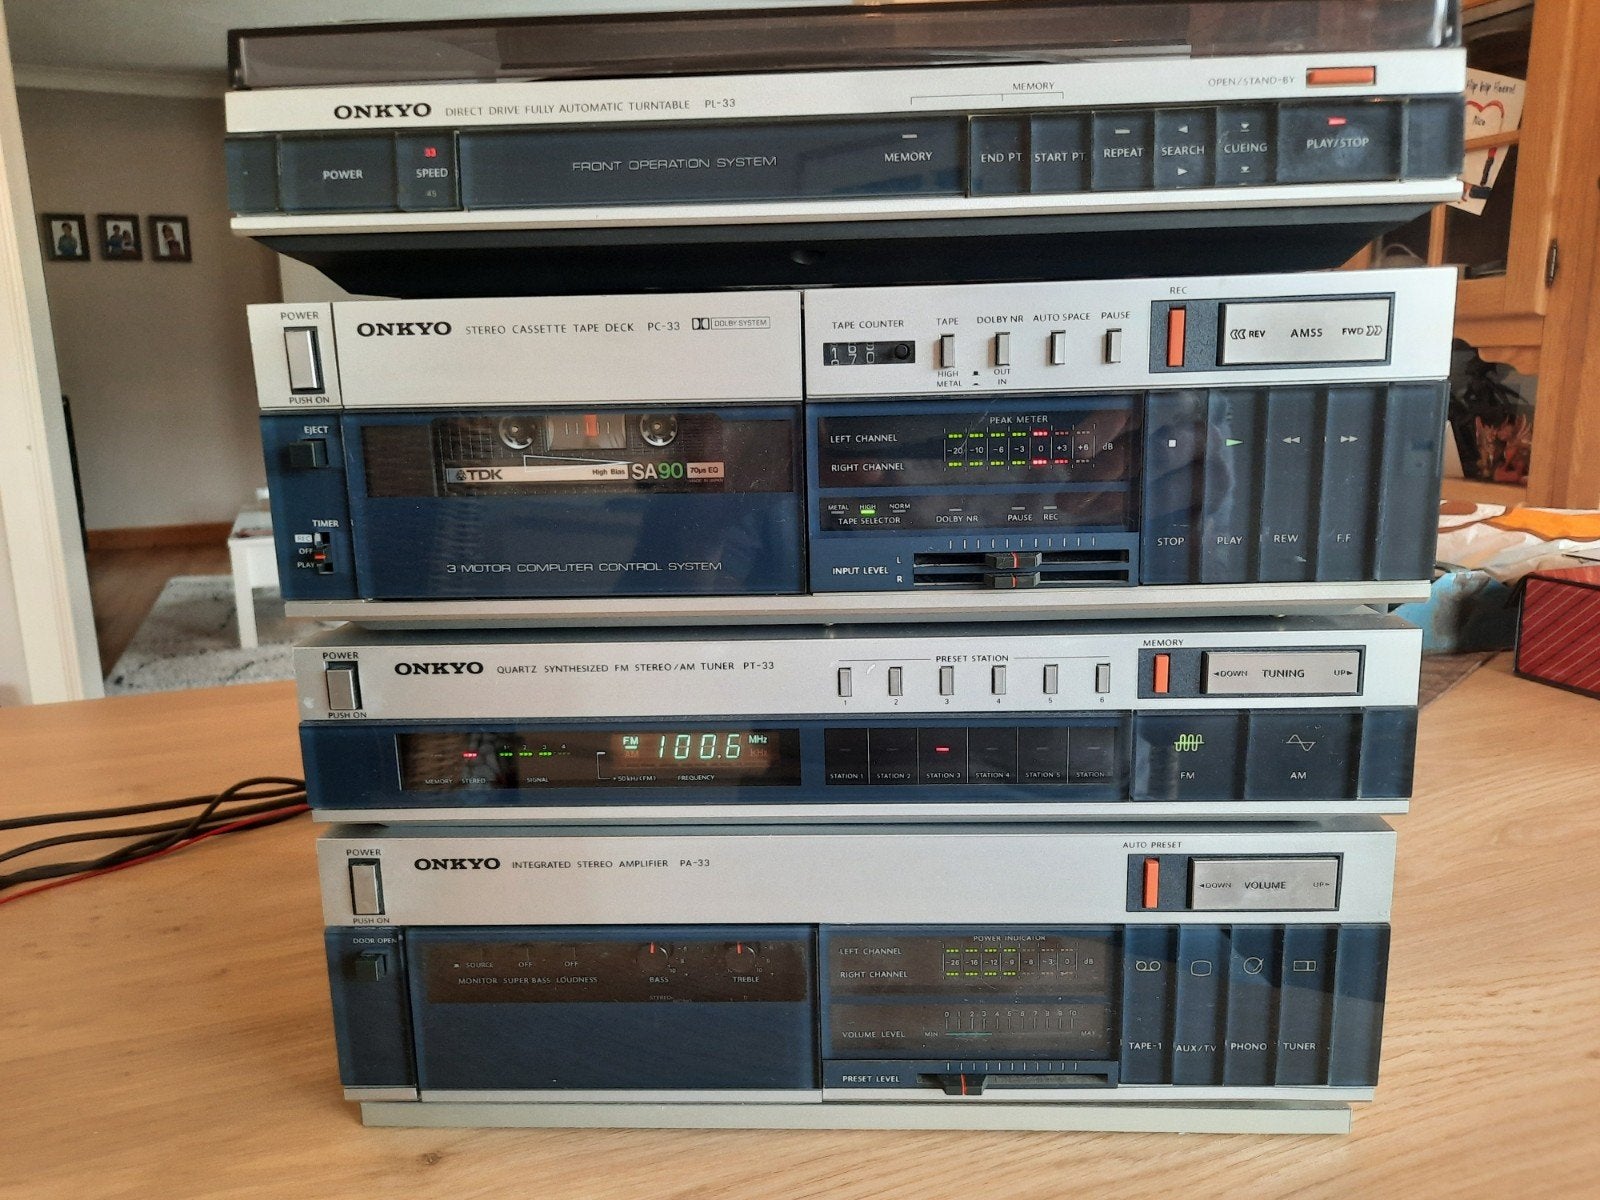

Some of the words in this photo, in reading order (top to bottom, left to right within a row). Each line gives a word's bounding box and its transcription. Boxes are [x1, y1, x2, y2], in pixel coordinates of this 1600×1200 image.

[1207, 76, 1295, 87] OPEN/STAND-BY
[1012, 82, 1056, 91] MEMORY
[445, 106, 483, 117] DIRECT
[488, 104, 519, 115] DRIVE
[525, 103, 555, 115] FULLY
[558, 101, 624, 114] AUTOMATIC
[629, 99, 690, 111] TURNTABLE
[704, 98, 736, 109] PL-33
[333, 102, 432, 120] ONKYO
[1306, 137, 1370, 149] PLAY/STOP
[1103, 147, 1144, 158] REPEAT
[1161, 145, 1205, 156] SEARCH
[1224, 143, 1268, 154] CUEING
[884, 151, 933, 162] MEMORY
[981, 153, 1004, 163] END
[1008, 152, 1022, 162] PT
[1034, 152, 1068, 162] START
[1072, 152, 1086, 162] PT
[572, 161, 622, 172] FRONT
[628, 158, 710, 170] OPERATION
[716, 156, 778, 167] SYSTEM
[322, 170, 363, 180] POWER
[416, 168, 449, 178] SPEED
[1169, 286, 1188, 295] REC
[280, 311, 319, 321] POWER
[976, 315, 1008, 324] DOLBY
[1010, 314, 1024, 323] NR
[1032, 313, 1060, 322] AUTO
[1062, 312, 1091, 321] SPACE
[1101, 311, 1131, 320] PAUSE
[647, 321, 681, 331] PC-33
[714, 318, 737, 328] DOLBY
[738, 317, 768, 327] SYSTEM
[832, 322, 855, 330] TAPE
[859, 320, 904, 329] COUNTER
[937, 317, 959, 326] TAPE
[356, 321, 452, 338] ONKYO
[465, 325, 506, 335] STEREO
[512, 324, 567, 334] CASSETTE
[574, 323, 600, 333] TAPE
[605, 322, 635, 333] DECK
[1290, 328, 1323, 338] AMSS
[1342, 327, 1364, 336] FWD
[1249, 330, 1266, 338] REV
[937, 370, 959, 378] HIGH
[936, 380, 962, 388] METAL
[315, 396, 330, 404] ON
[990, 415, 1013, 424] PEAK
[1017, 415, 1048, 424] METER
[303, 425, 329, 435] EJECT
[830, 435, 851, 444] LEFT
[855, 434, 898, 443] CHANNEL
[947, 447, 963, 455] -20
[969, 446, 985, 454] -10
[831, 464, 858, 472] RIGHT
[862, 463, 904, 471] CHANNEL
[467, 469, 502, 481] TDK
[592, 468, 608, 477] High
[610, 468, 626, 476] Bias
[312, 519, 339, 528] TIMER
[936, 515, 963, 523] DOLBY
[1157, 537, 1185, 546] STOP
[1217, 536, 1243, 545] PLAY
[1273, 533, 1298, 543] REW
[447, 565, 457, 573] 3
[461, 564, 511, 573] MOTOR
[516, 563, 594, 572] COMPUTER
[599, 562, 662, 572] CONTROL
[668, 562, 722, 571] SYSTEM
[863, 567, 889, 575] LEVEL
[1143, 639, 1184, 647] MEMORY
[322, 652, 359, 660] POWER
[972, 654, 1009, 662] STATION
[394, 661, 484, 676] ONKYO
[496, 665, 537, 674] QUARTZ
[544, 664, 609, 673] SYNTHESIZED
[614, 664, 629, 672] FM
[701, 661, 735, 670] TUNER
[743, 661, 775, 670] PT-33
[1220, 670, 1248, 678] DOWN
[1262, 669, 1305, 679] TUNING
[328, 711, 350, 719] PUSH
[623, 736, 639, 745] FM
[748, 735, 767, 744] MHz
[658, 734, 741, 759] 100.6
[1180, 771, 1195, 780] FM
[1290, 771, 1307, 780] AM
[1151, 841, 1182, 849] PRESET
[414, 858, 501, 871] ONKYO
[512, 861, 571, 869] INTEGRATED
[577, 860, 613, 868] STEREO
[619, 859, 669, 868] AMPLIFIER
[680, 859, 710, 867] PA-33
[1244, 881, 1286, 890] VOLUME
[840, 947, 858, 955] LEFT
[863, 947, 902, 955] CHANNEL
[869, 970, 908, 978] CHANNEL
[458, 977, 498, 985] MONITOR
[531, 976, 550, 984] BASS
[1129, 1042, 1162, 1050] TAPE-1
[1176, 1044, 1217, 1052] AUX/TV
[1231, 1042, 1267, 1051] PHONO
[1283, 1042, 1316, 1050] TUNER
[842, 1075, 872, 1083] PRESET
[876, 1075, 900, 1083] LEVEL
